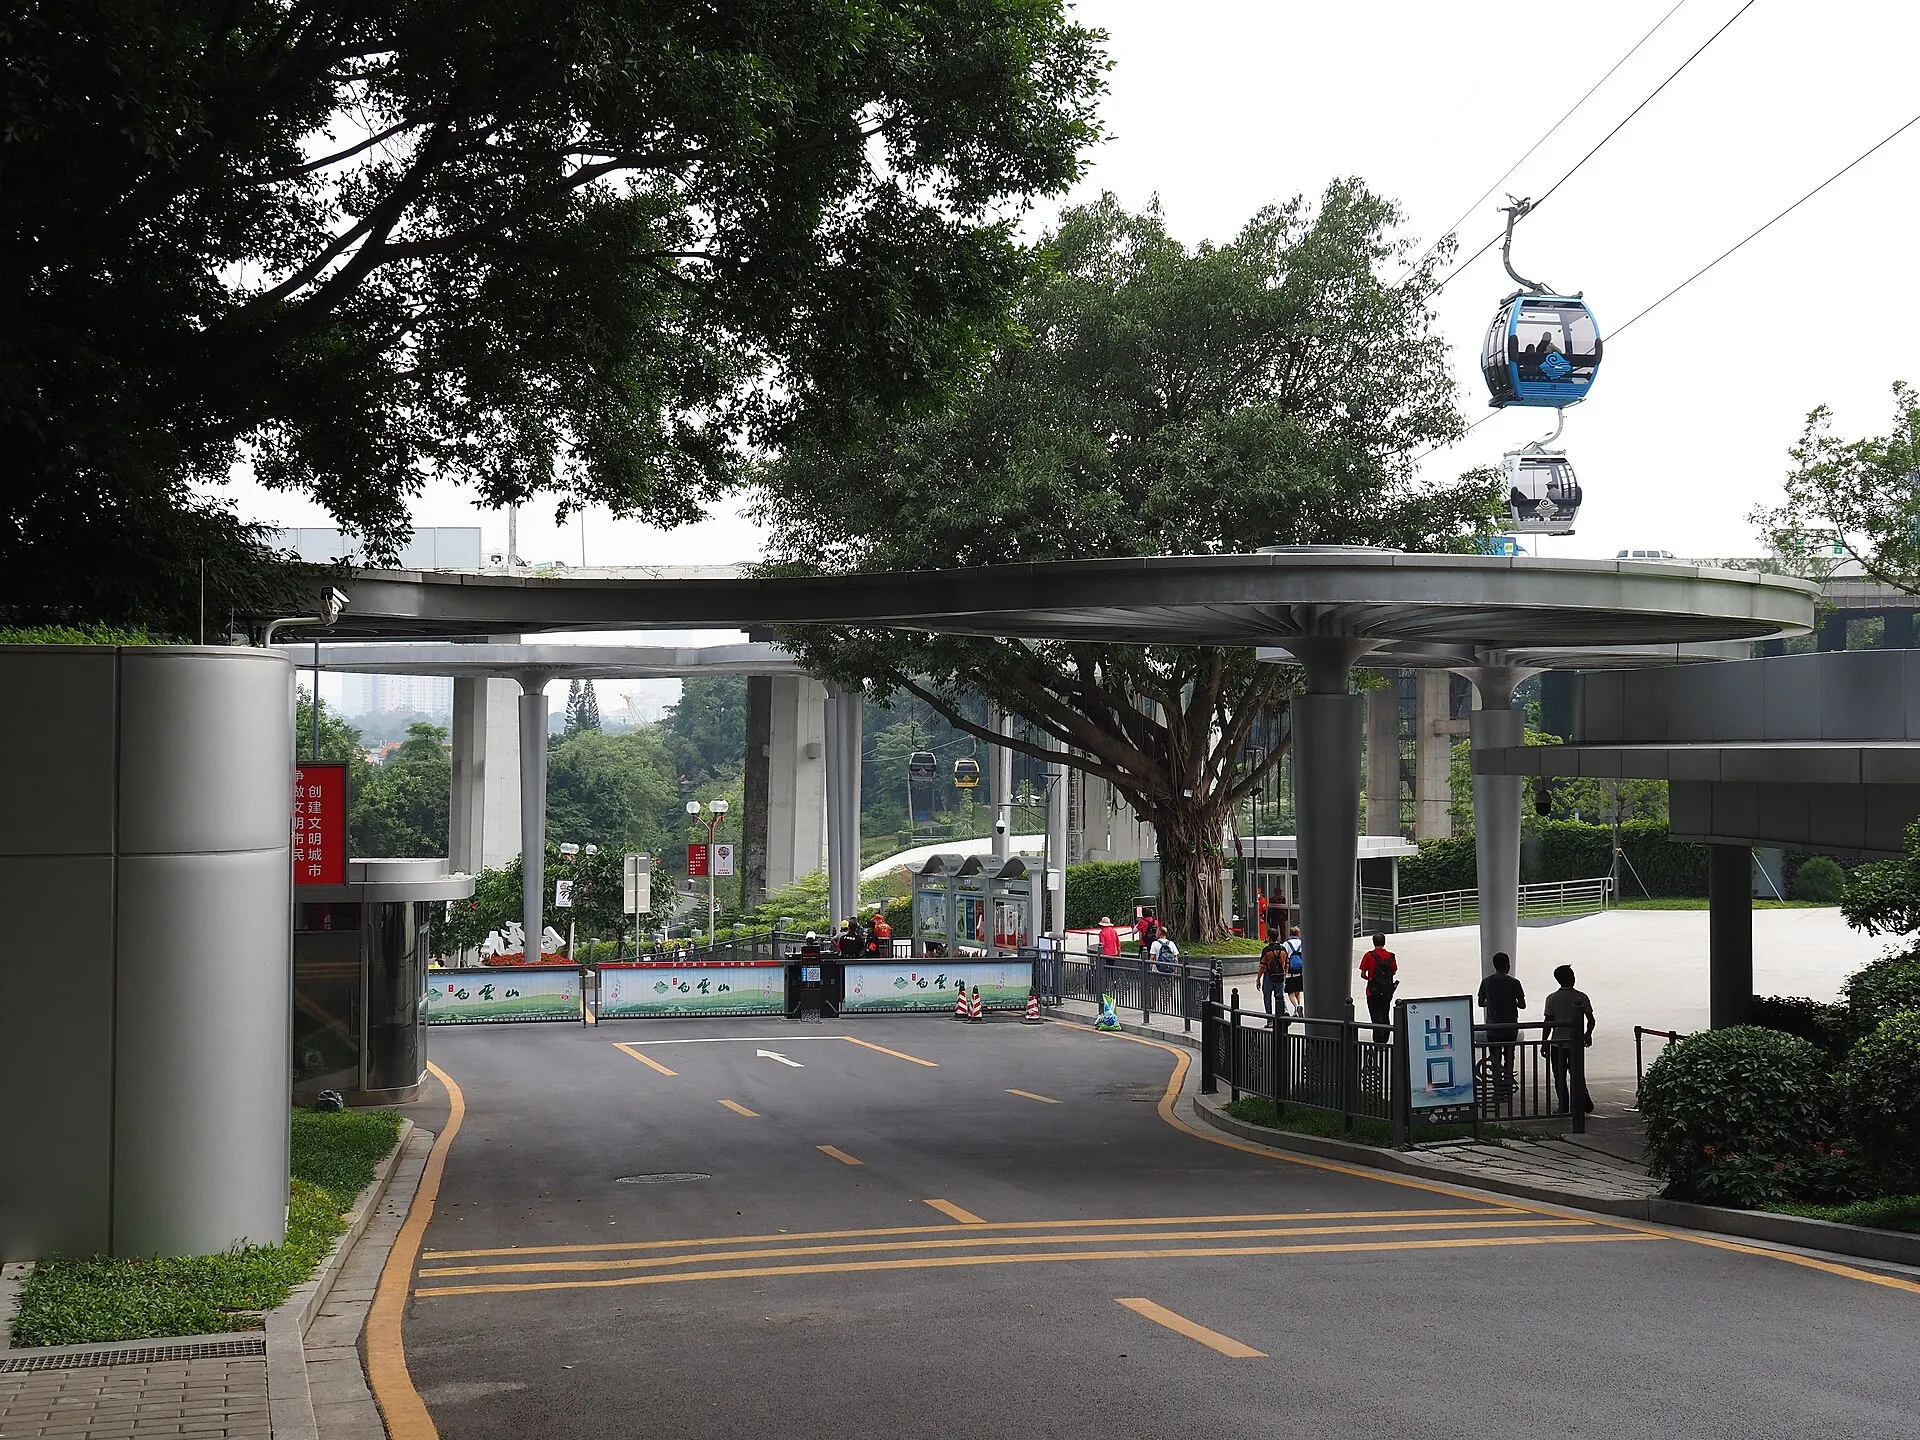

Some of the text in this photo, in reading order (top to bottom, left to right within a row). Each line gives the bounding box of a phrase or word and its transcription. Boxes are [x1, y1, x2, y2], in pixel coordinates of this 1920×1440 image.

[308, 784, 322, 877] 创建文明城市
[1424, 1014, 1455, 1089] 出口
